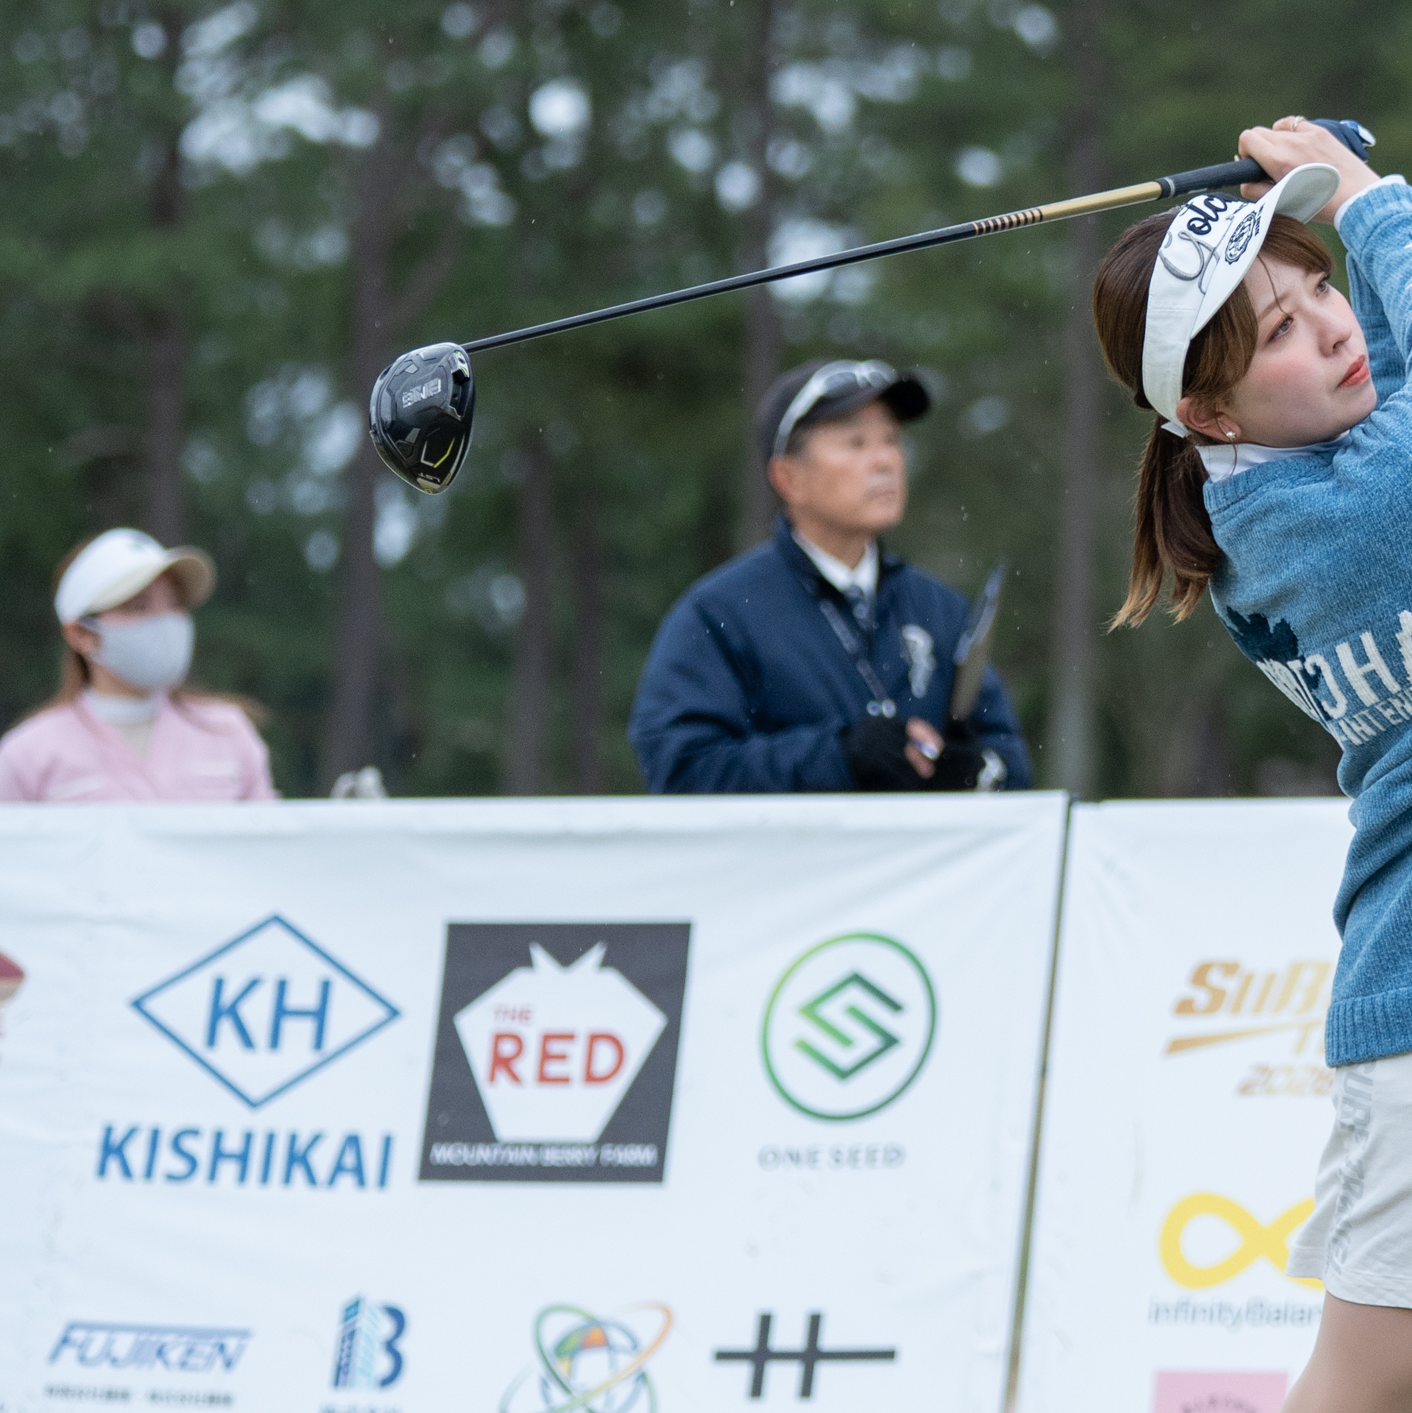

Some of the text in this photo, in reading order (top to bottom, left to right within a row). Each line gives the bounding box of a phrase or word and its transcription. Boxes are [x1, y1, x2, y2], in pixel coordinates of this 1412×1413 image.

[205, 976, 333, 1051] KH
[493, 1004, 533, 1025] THE
[488, 1032, 626, 1087] RED
[97, 1124, 394, 1189] KISHIKAI
[430, 1142, 538, 1166] MOUNTAIN
[47, 1320, 252, 1373] FUJIKEN
